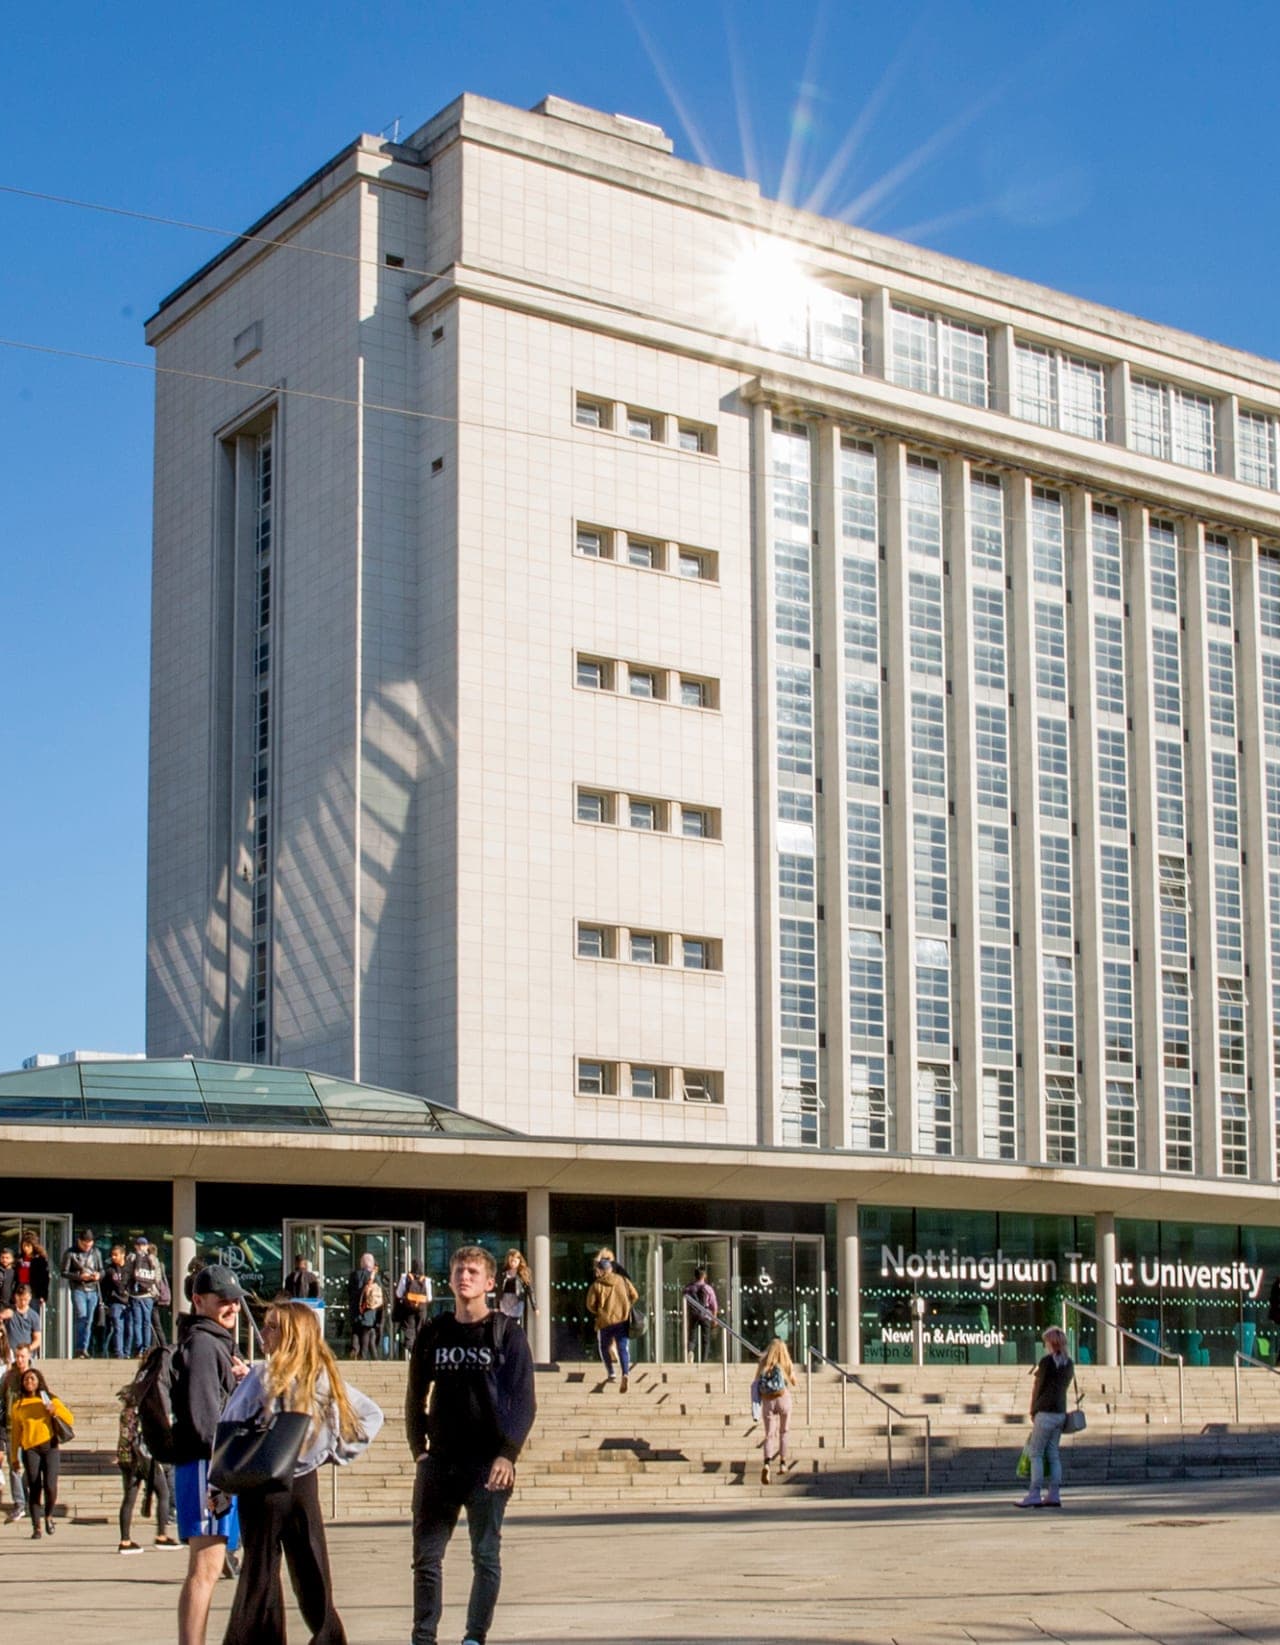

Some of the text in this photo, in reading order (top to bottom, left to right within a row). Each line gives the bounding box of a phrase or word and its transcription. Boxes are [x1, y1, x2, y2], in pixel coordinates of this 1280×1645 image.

[881, 1244, 1056, 1289] Nottingham
[1140, 1256, 1263, 1298] University
[881, 1328, 1005, 1348] Newtn & Arkwright
[435, 1346, 492, 1365] BOSS
